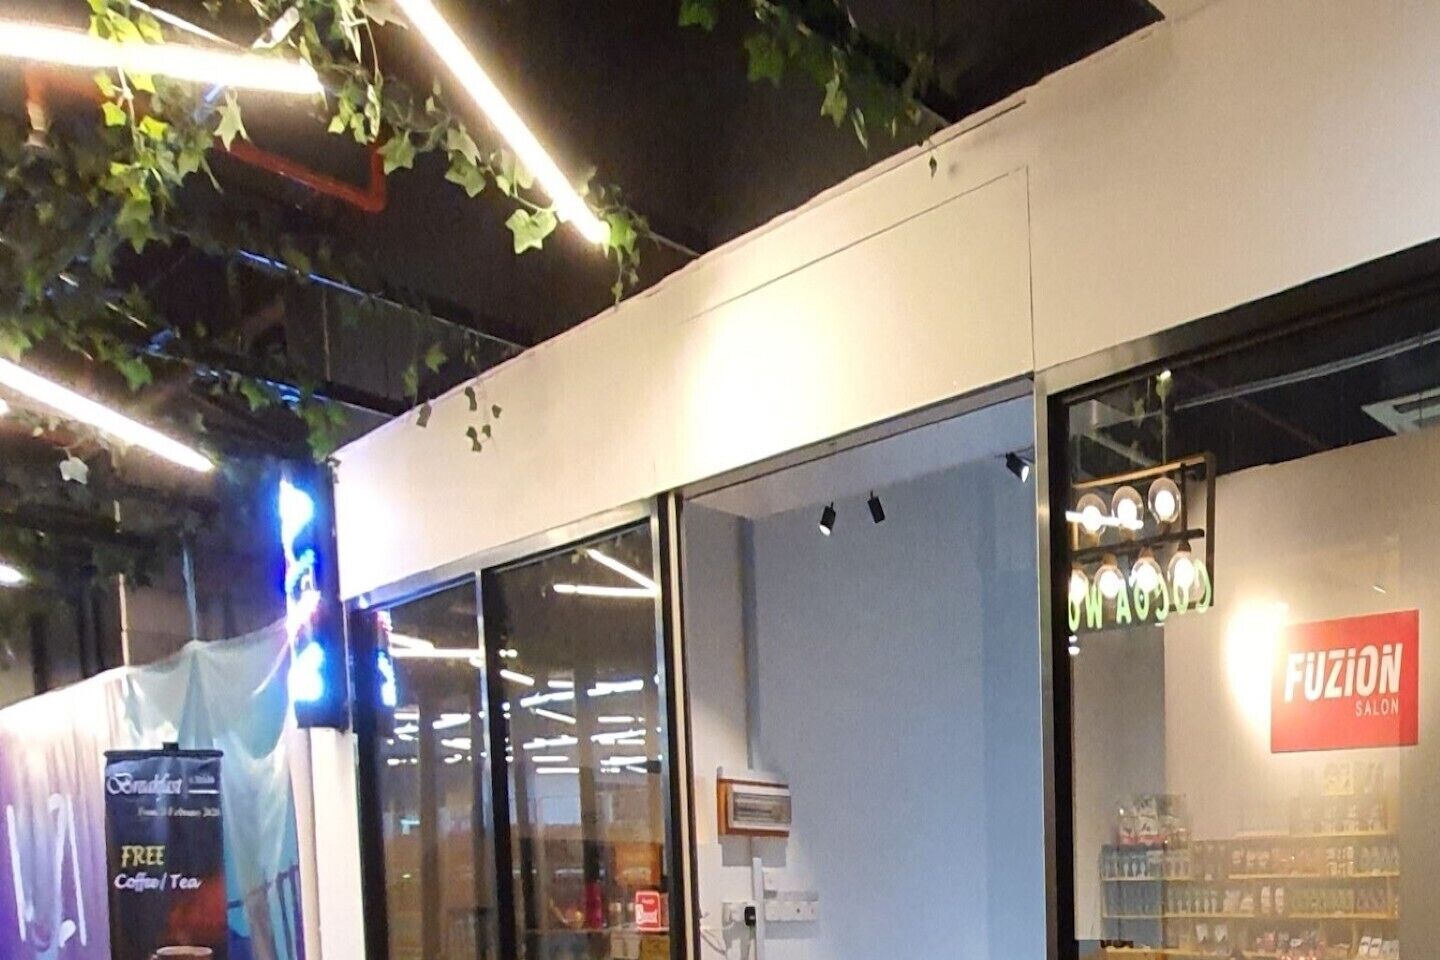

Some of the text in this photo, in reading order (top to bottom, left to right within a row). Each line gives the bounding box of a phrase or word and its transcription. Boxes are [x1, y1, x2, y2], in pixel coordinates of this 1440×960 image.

[1355, 698, 1399, 717] SALON
[121, 844, 166, 868] FREE
[169, 872, 203, 890] Tea
